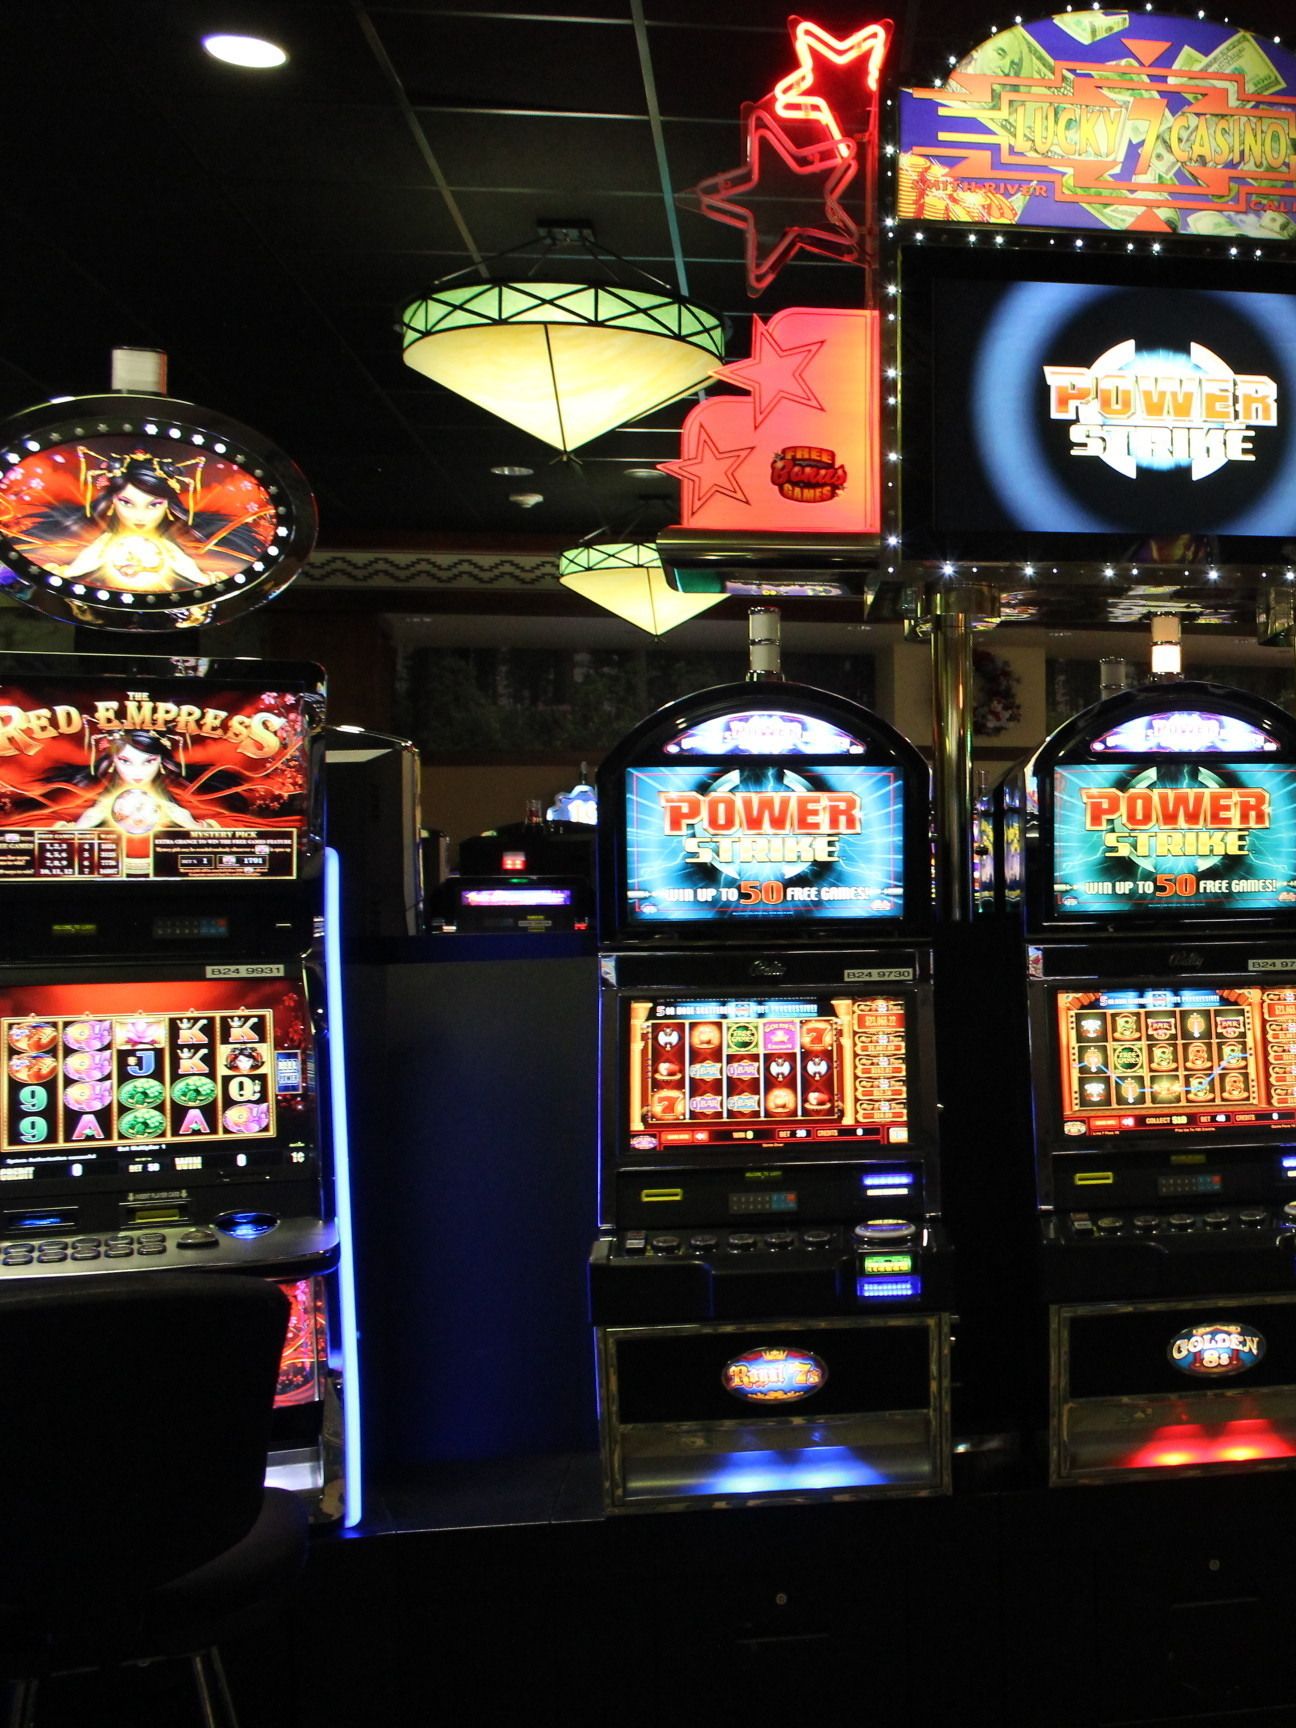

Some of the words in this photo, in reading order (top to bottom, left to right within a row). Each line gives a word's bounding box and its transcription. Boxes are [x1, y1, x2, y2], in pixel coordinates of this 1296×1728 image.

[1014, 105, 1123, 158] LUCKY
[1127, 98, 1168, 176] 7
[1170, 113, 1287, 169] CASINO
[913, 179, 975, 193] SMITH
[984, 182, 1048, 197] RIVER
[1043, 365, 1278, 426] POWER
[783, 447, 833, 462] FREE
[1069, 423, 1256, 461] STRIKE
[783, 485, 833, 501] GAMES
[128, 691, 150, 702] THE
[0, 705, 83, 757] RED
[95, 701, 287, 759] EMPRESS
[658, 791, 862, 836] POWER
[1080, 788, 1272, 831] POWER
[684, 835, 839, 863] STRIKE
[1103, 831, 1250, 857] STRIKE
[667, 888, 692, 901] WIN
[695, 888, 713, 901] UP
[720, 888, 738, 901] TO
[739, 880, 784, 904] 50
[786, 887, 818, 901] FREE
[820, 887, 871, 901] GAMES!
[1086, 881, 1113, 894] WIN
[1116, 881, 1134, 894] UP
[1136, 881, 1154, 894] TO
[1155, 873, 1197, 897] 50
[1199, 880, 1229, 893] FREE
[1231, 880, 1277, 893] GAMES!
[212, 967, 240, 976] B24
[246, 966, 281, 975] 9931
[847, 971, 873, 979] B24
[877, 970, 910, 979] 9730
[1251, 961, 1277, 969] B24
[19, 1085, 48, 1112] 9
[19, 1116, 48, 1143] 9
[72, 1113, 104, 1140] A
[179, 1108, 211, 1135] A
[1172, 1333, 1259, 1360] GOLDEN
[730, 1364, 786, 1389] Royal
